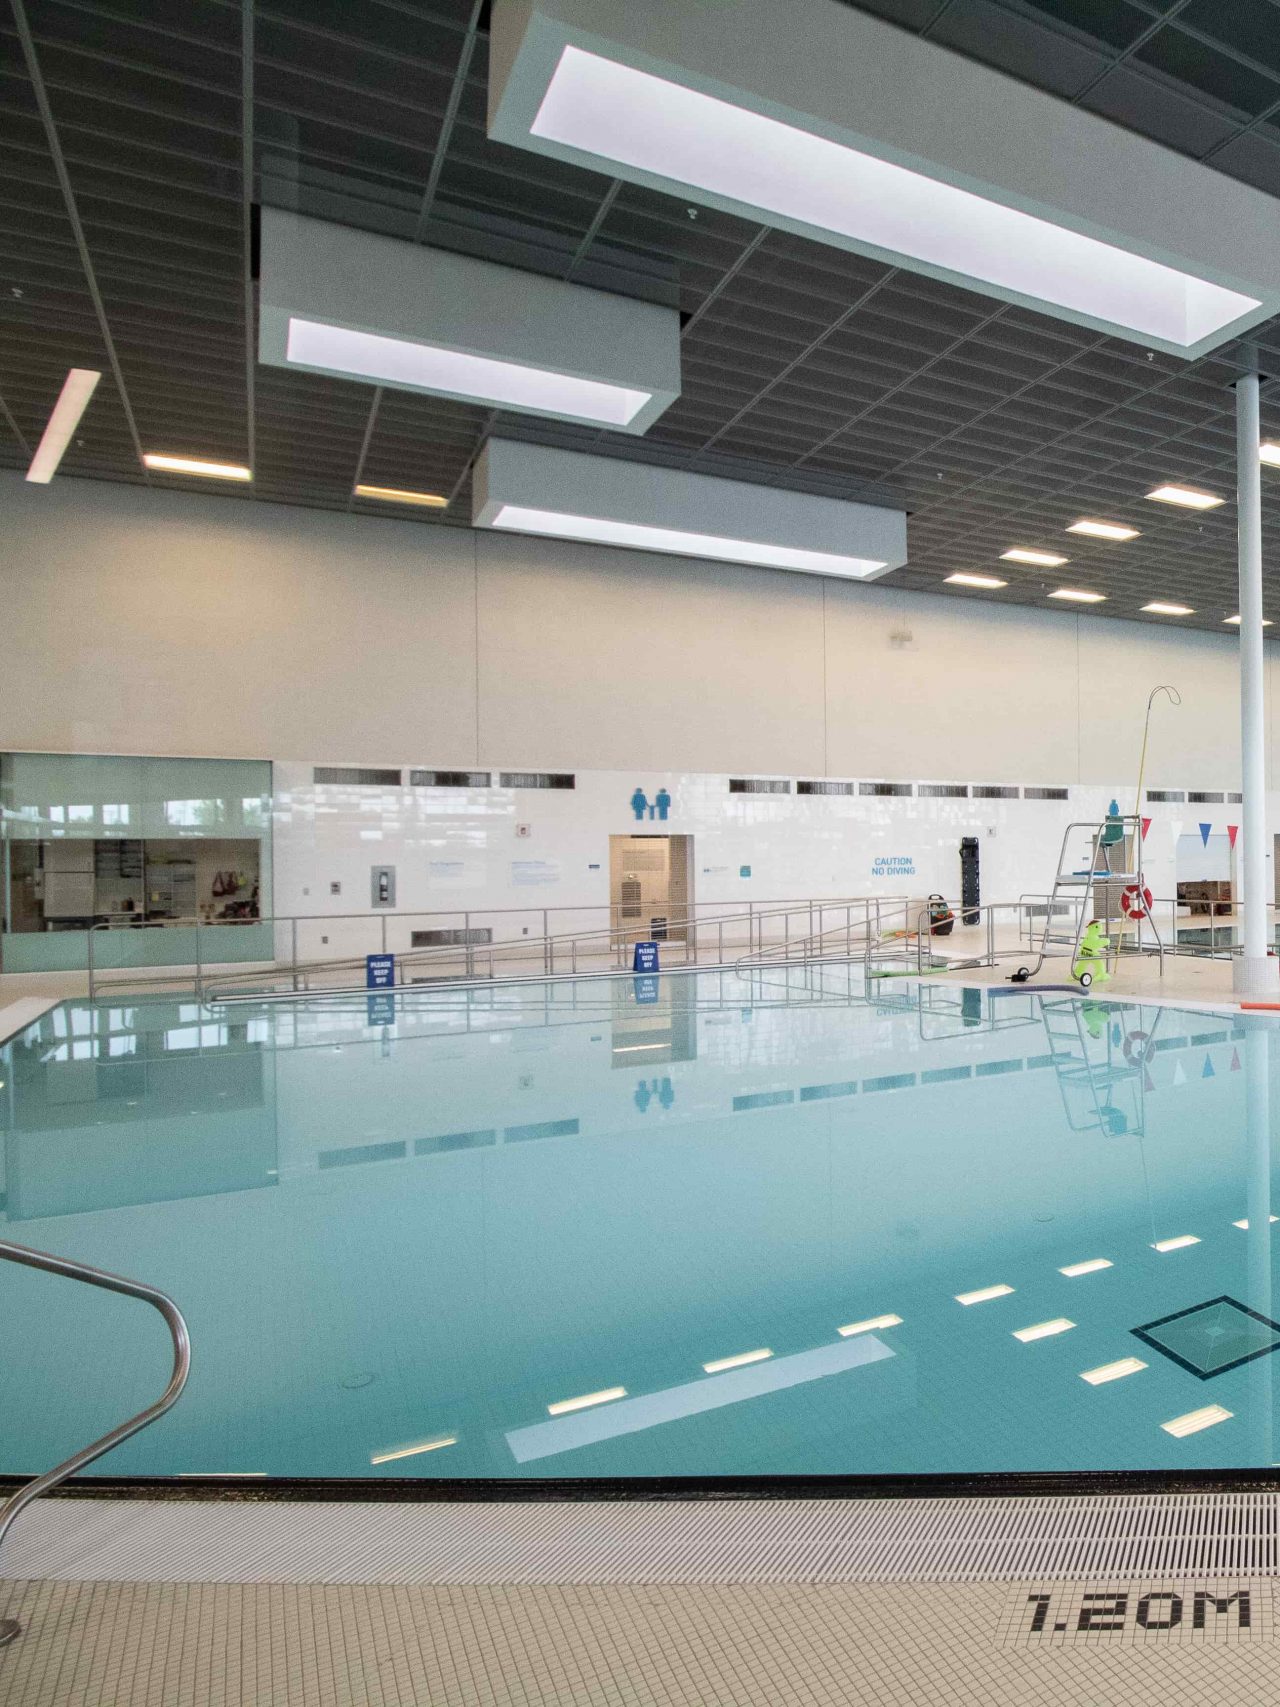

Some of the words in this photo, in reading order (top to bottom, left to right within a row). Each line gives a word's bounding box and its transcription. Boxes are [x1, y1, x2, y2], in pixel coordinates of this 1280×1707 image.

[874, 857, 913, 865] CAUTION
[872, 867, 885, 875] NO
[887, 867, 915, 875] DIVING
[1028, 1590, 1251, 1632] 1.20M
